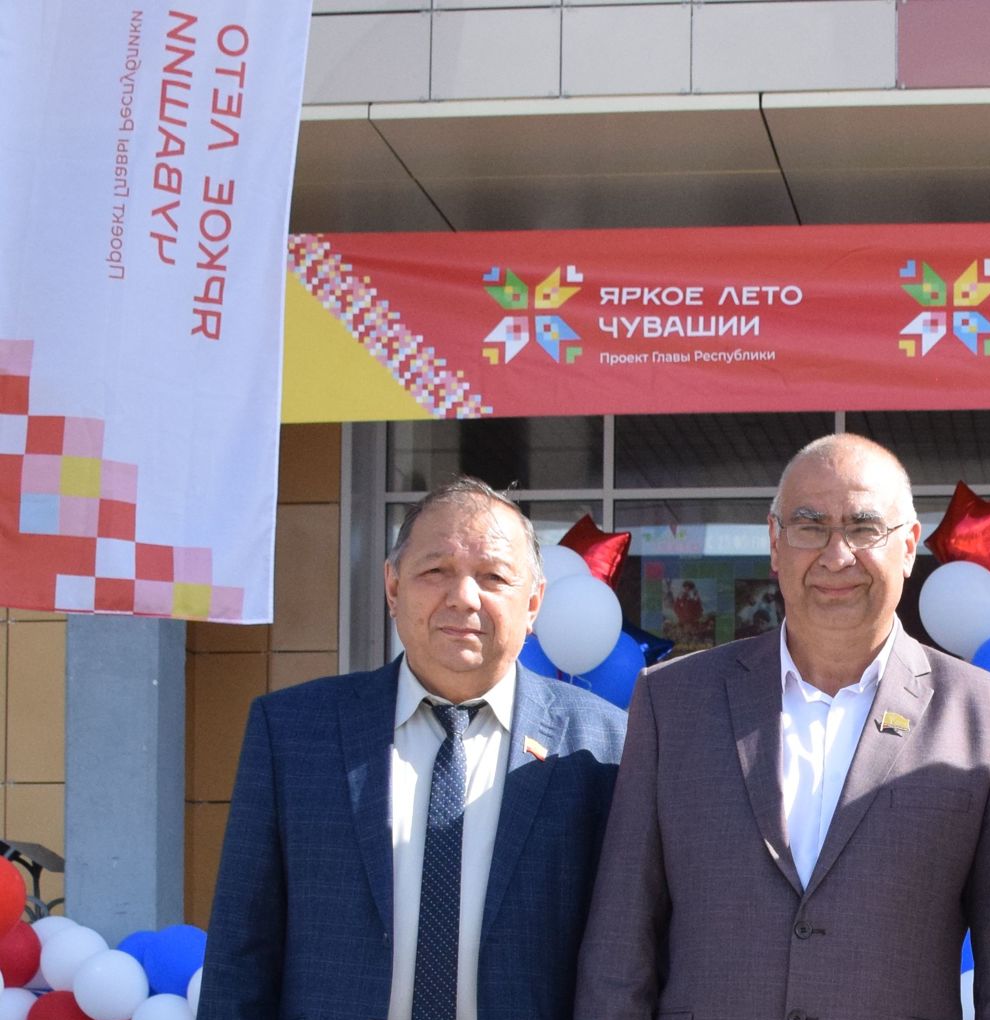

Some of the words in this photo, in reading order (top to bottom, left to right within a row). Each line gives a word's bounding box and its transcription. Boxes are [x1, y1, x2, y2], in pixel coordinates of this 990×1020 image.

[599, 286, 704, 306] ЯРКОЕ
[718, 284, 803, 306] ЛЕТО
[598, 315, 760, 339] ЧУВАШИИ
[599, 351, 649, 366] Проект
[652, 351, 691, 363] Главы
[694, 348, 776, 364] Республики
